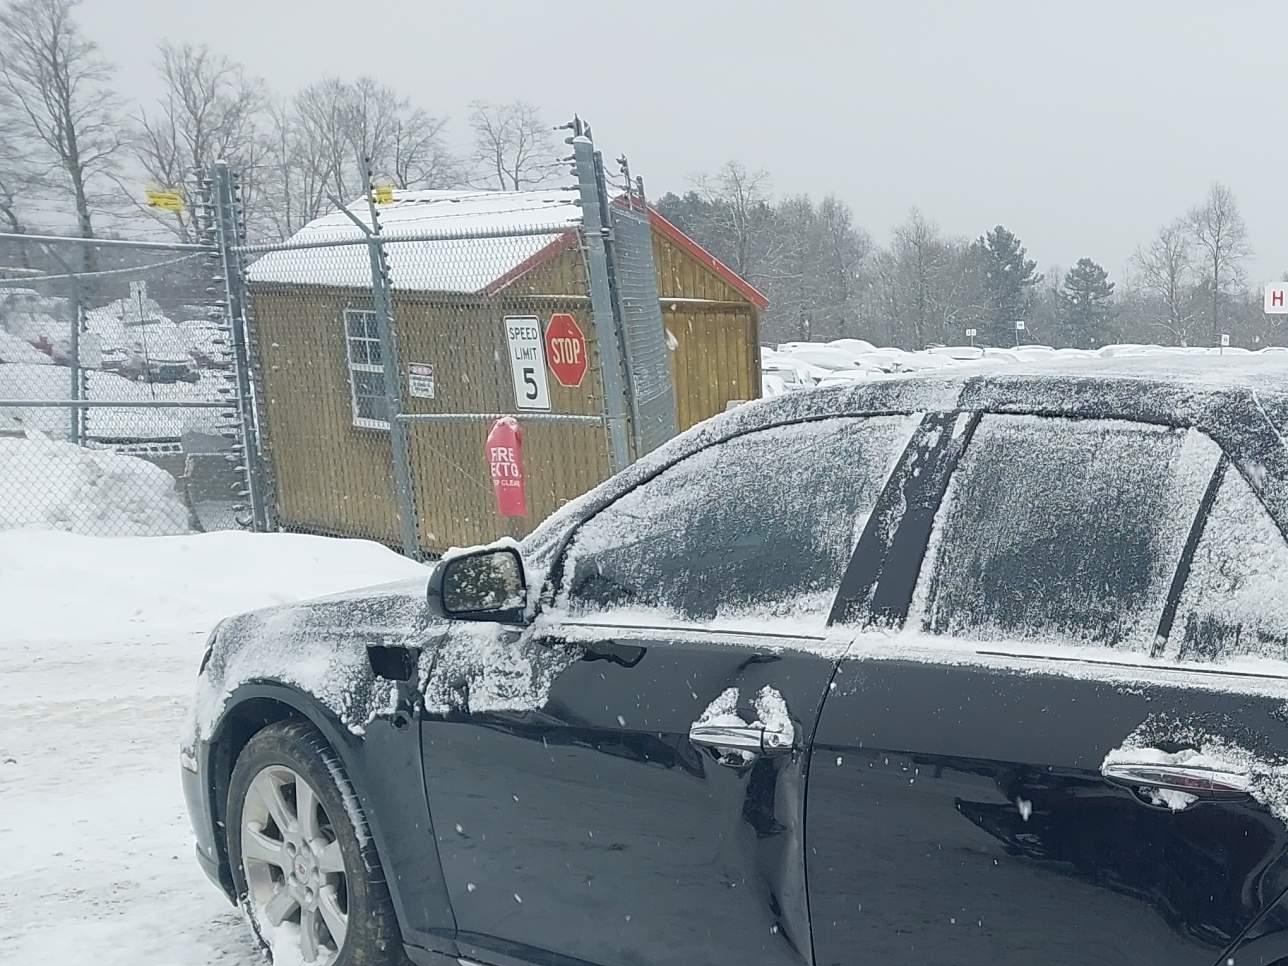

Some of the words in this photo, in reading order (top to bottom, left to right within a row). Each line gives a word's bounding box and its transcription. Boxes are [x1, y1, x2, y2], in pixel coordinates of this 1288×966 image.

[1272, 290, 1284, 307] H
[509, 327, 538, 340] SPEED
[514, 347, 537, 360] LIMIT
[551, 337, 581, 365] STOP
[523, 367, 538, 400] 5
